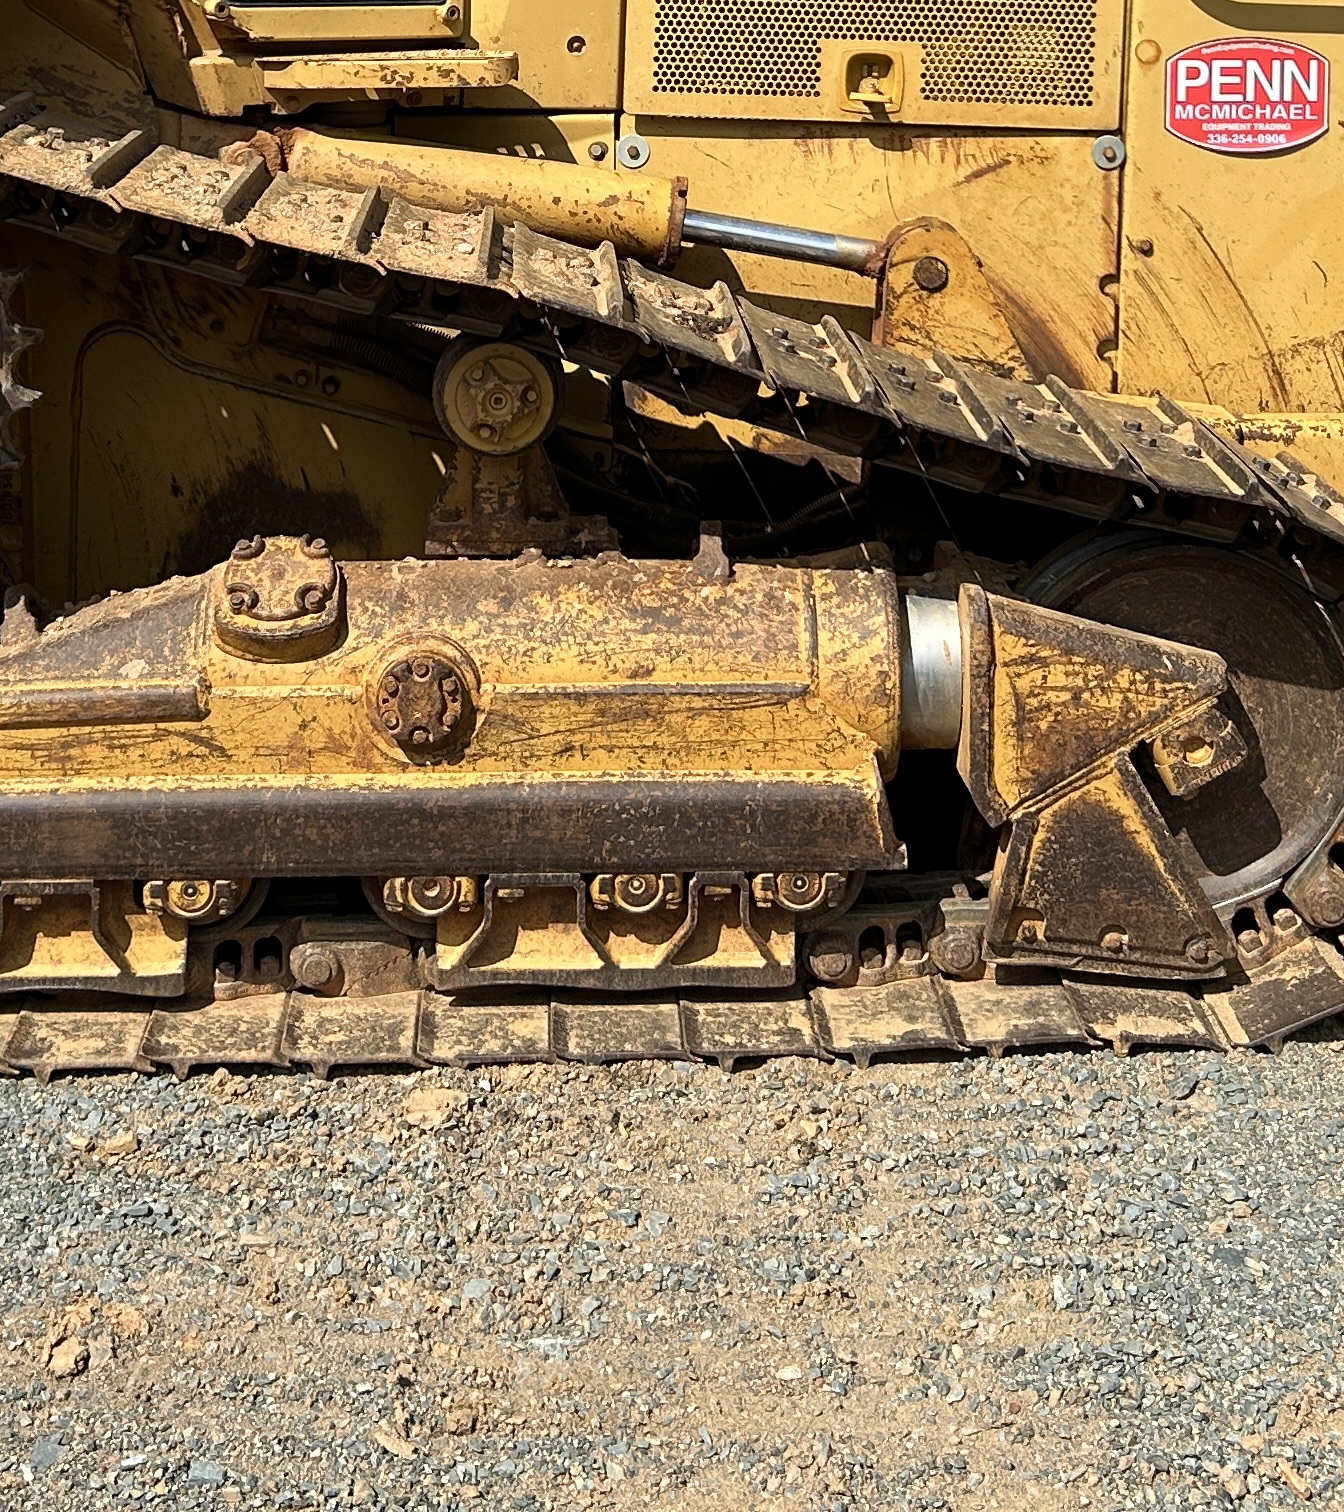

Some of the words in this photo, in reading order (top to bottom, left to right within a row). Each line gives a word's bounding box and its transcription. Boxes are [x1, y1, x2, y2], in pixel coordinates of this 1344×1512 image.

[1176, 58, 1319, 102] PENN
[1174, 103, 1319, 120] MCMICHAEL
[1202, 122, 1252, 131] EQUIPMENT
[1254, 122, 1292, 131] TRADING
[1206, 133, 1287, 144] 336-254-0906
